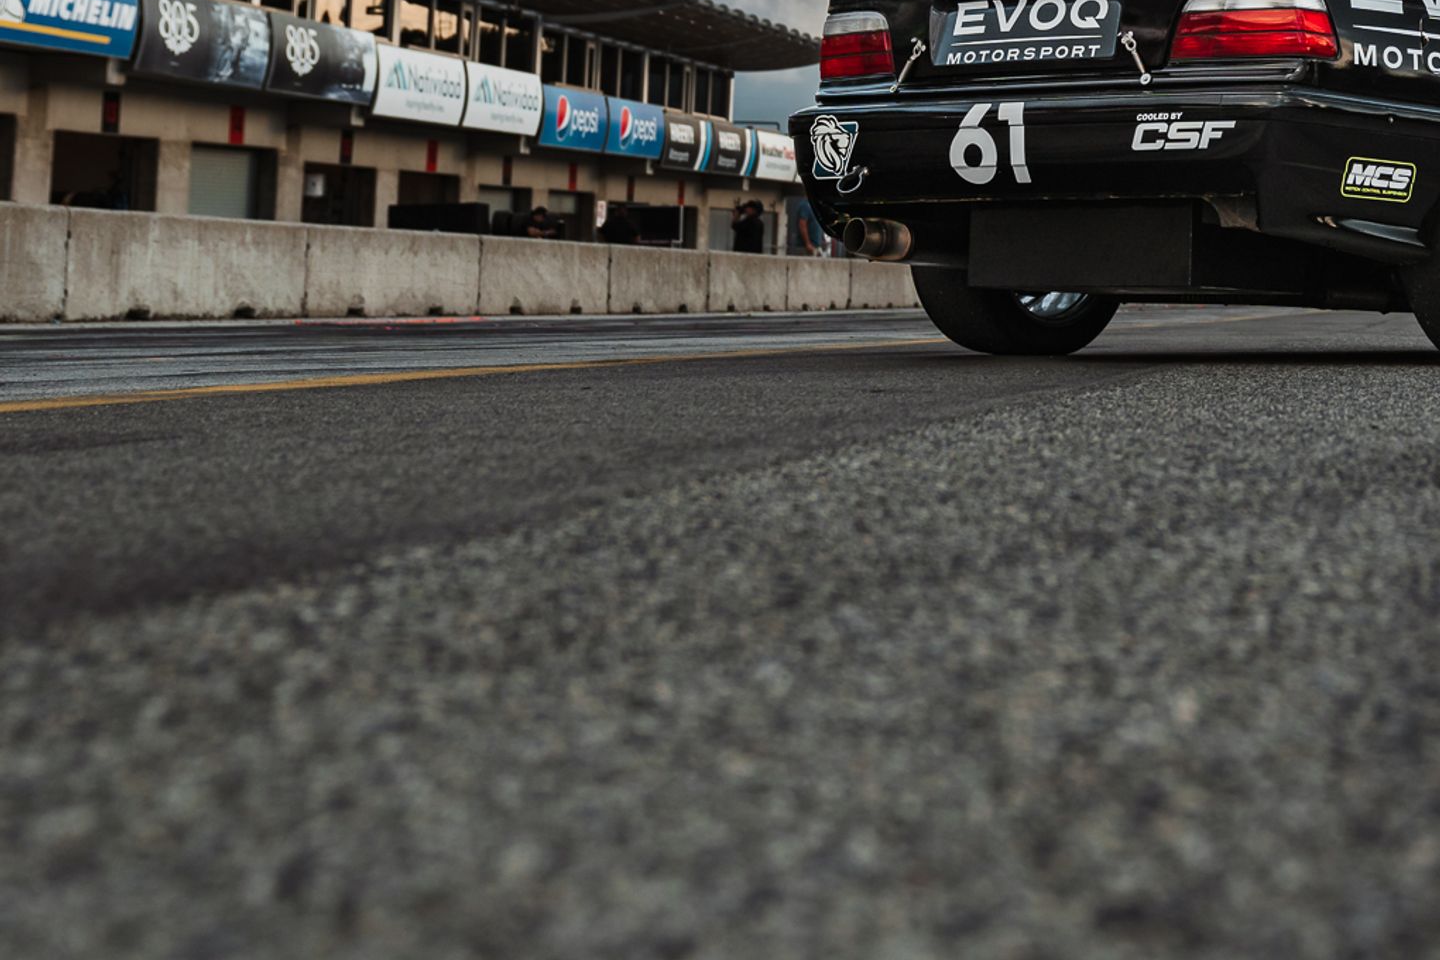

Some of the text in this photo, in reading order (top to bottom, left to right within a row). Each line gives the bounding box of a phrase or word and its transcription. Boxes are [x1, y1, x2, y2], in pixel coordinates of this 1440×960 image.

[286, 24, 320, 67] 805
[946, 45, 1101, 65] MOTORSPORT
[569, 107, 599, 138] pepsi
[630, 116, 657, 146] pepsi
[1136, 113, 1169, 121] COOLED
[949, 103, 1031, 184] 61
[1131, 120, 1236, 151] CSF
[1346, 163, 1412, 190] MCS
